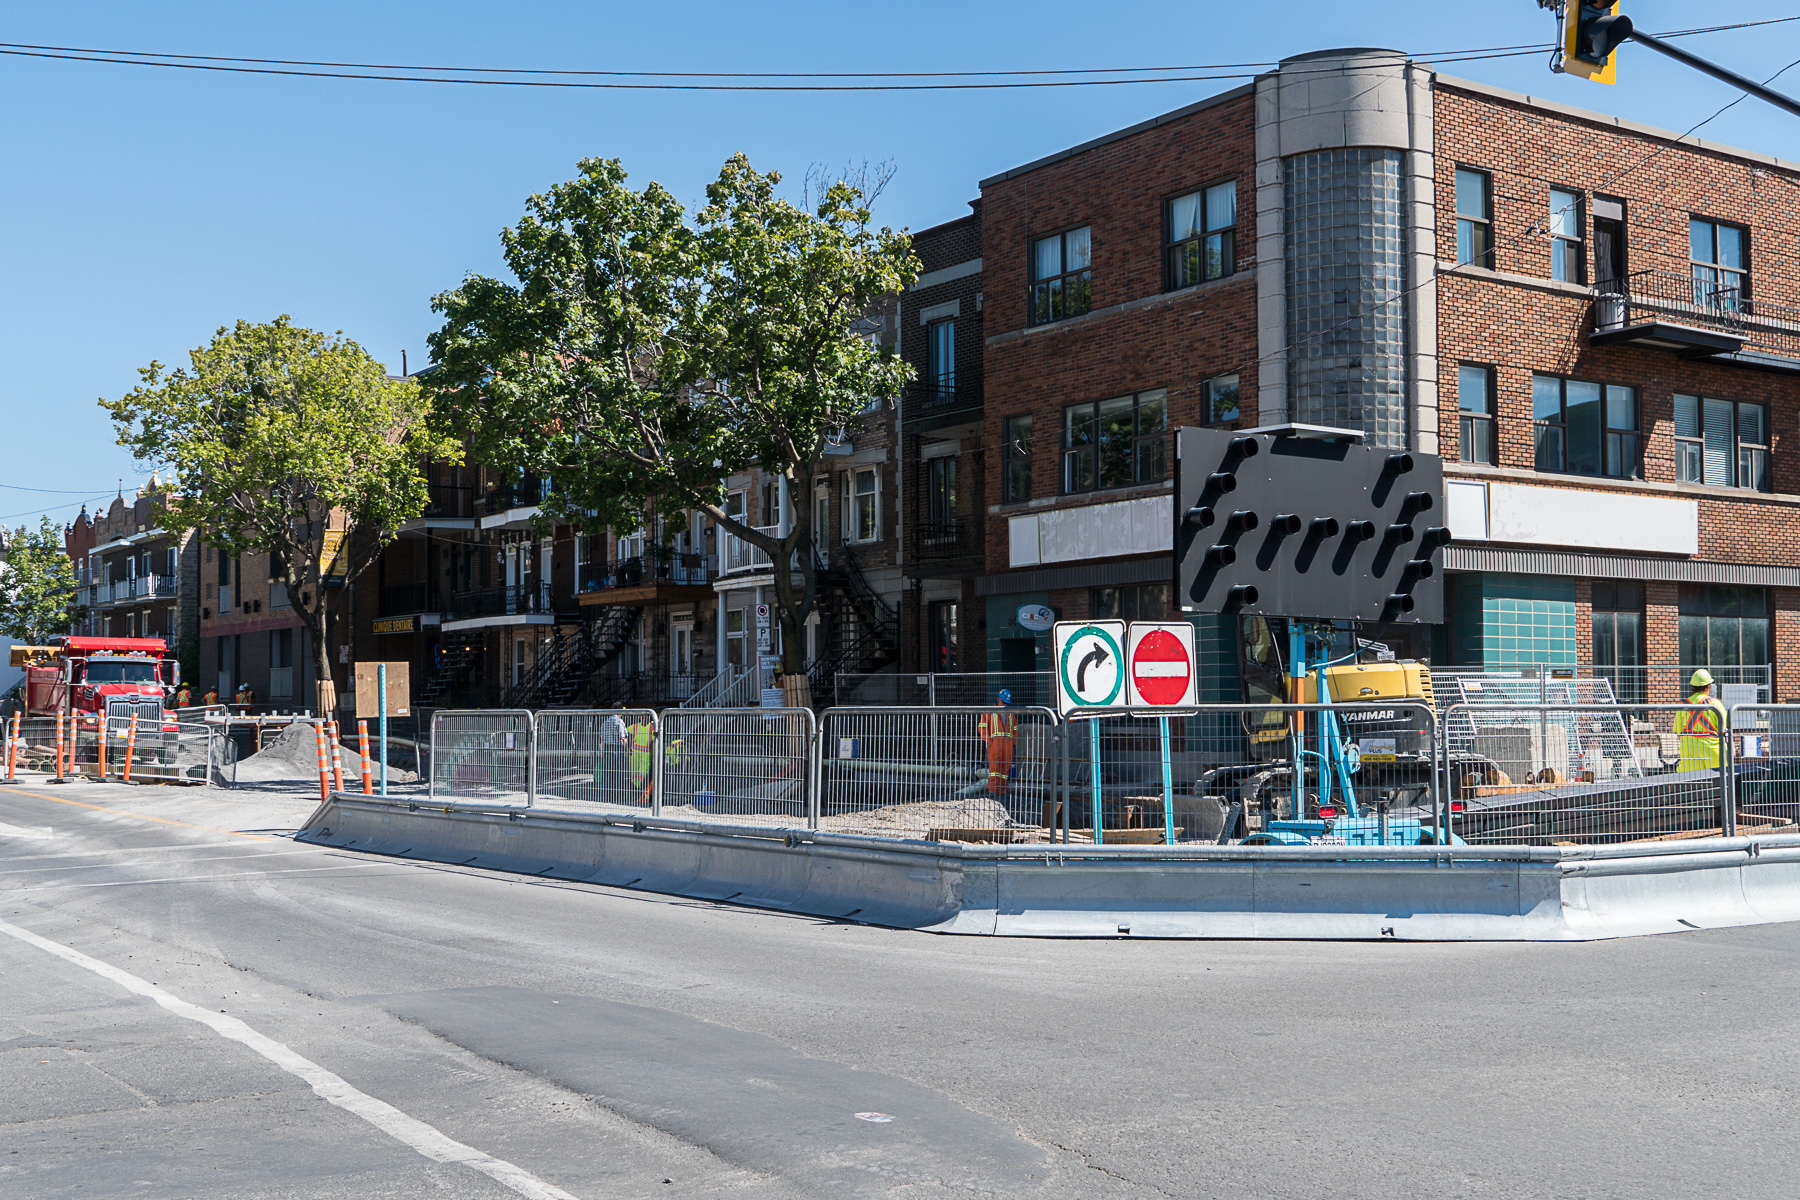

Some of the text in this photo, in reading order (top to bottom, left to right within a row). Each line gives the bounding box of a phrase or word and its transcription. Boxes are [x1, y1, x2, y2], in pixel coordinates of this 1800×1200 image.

[373, 619, 413, 632] CLINIQUE DENTAIRE
[760, 629, 766, 637] P
[1340, 710, 1395, 722] YANMAR
